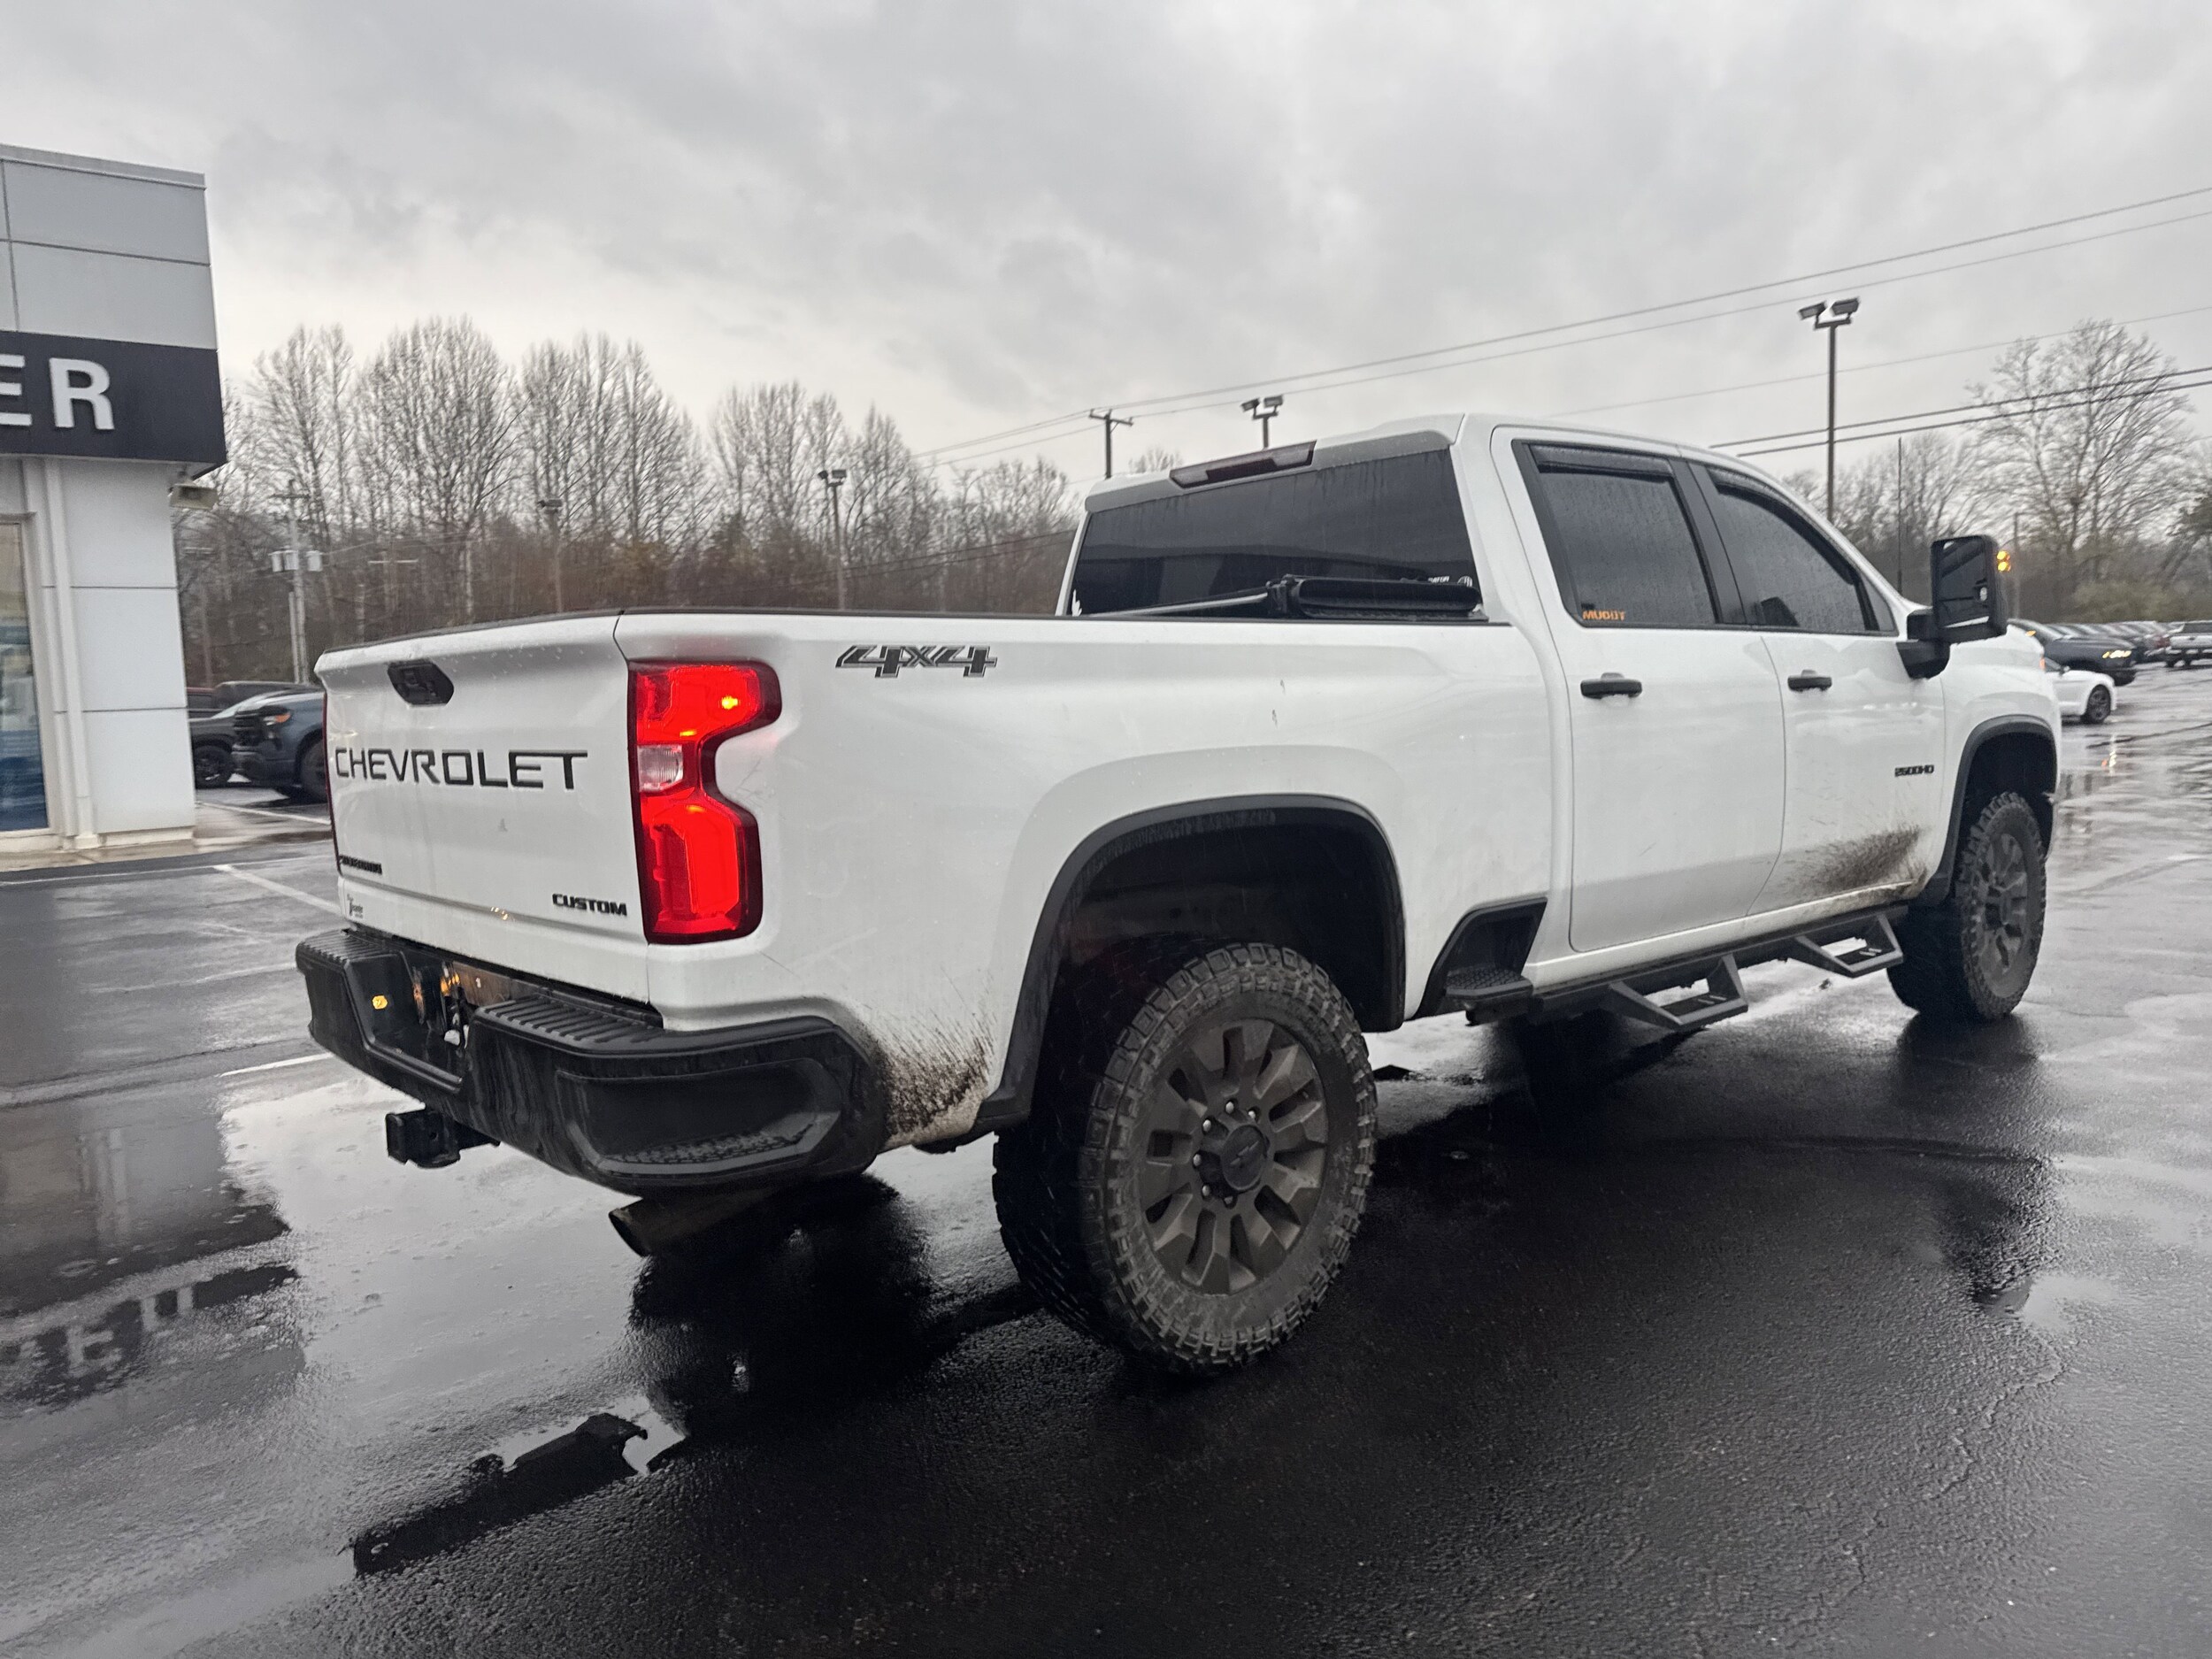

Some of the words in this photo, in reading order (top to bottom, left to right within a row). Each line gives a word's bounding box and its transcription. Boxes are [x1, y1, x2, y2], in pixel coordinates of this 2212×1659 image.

[1582, 610, 1624, 621] MUDDY
[335, 749, 588, 789] CHEVROLET
[552, 893, 627, 917] CUSTOM
